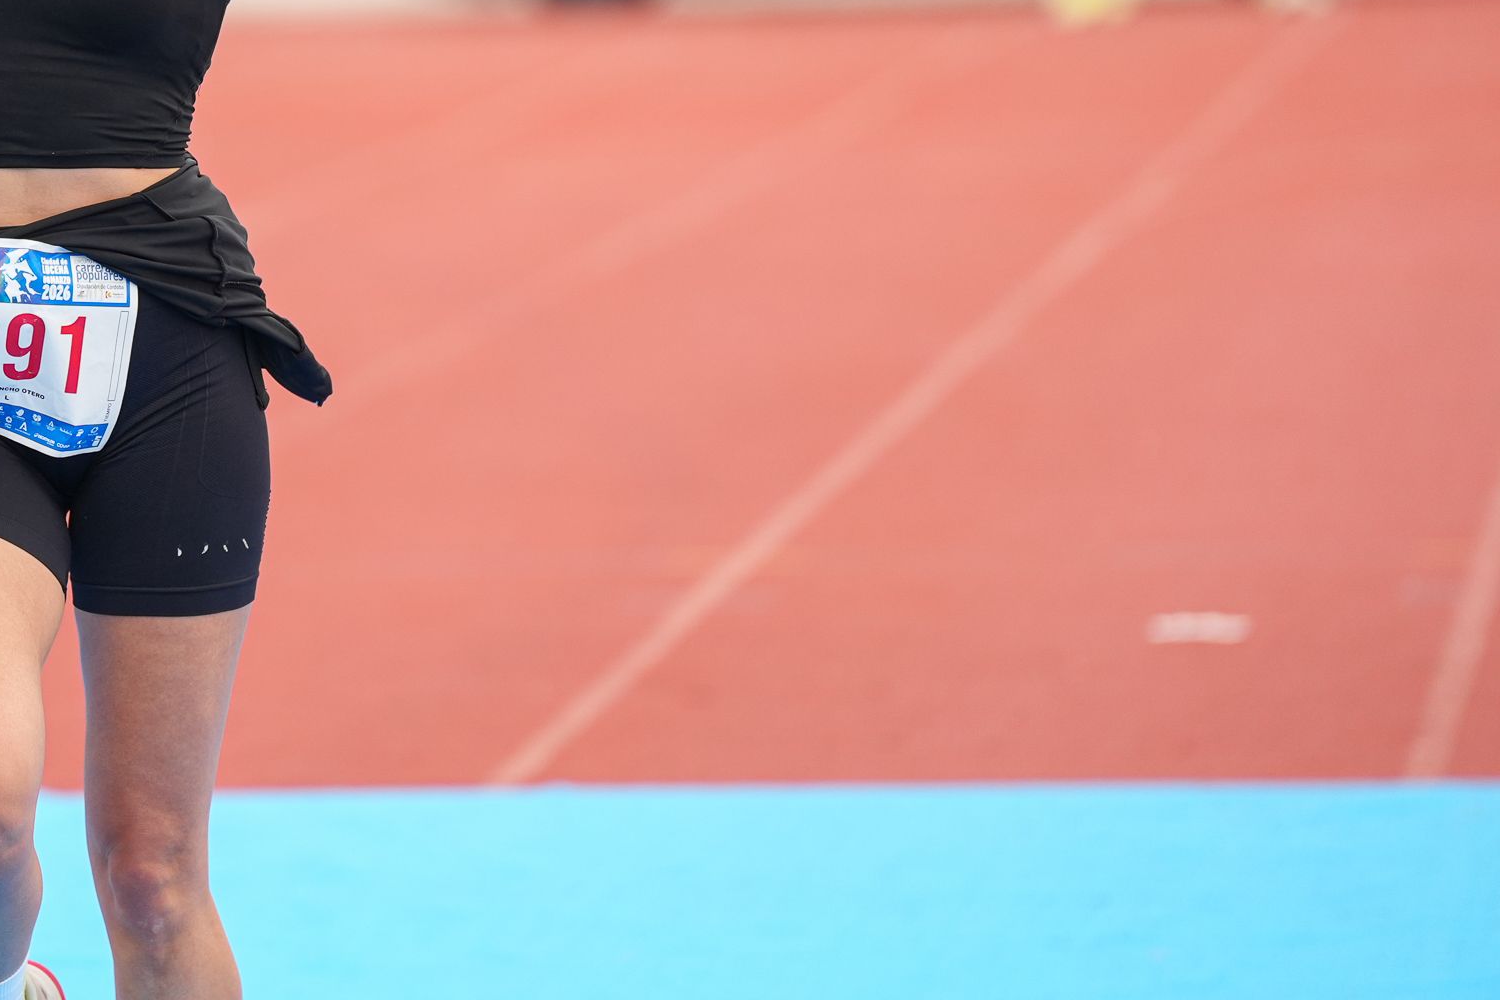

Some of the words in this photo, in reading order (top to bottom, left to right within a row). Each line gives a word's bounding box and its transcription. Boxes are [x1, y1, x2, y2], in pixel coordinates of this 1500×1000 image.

[76, 271, 124, 283] populares
[41, 284, 71, 301] 2026
[21, 388, 45, 400] OTERO
[104, 402, 113, 422] TIEMPO
